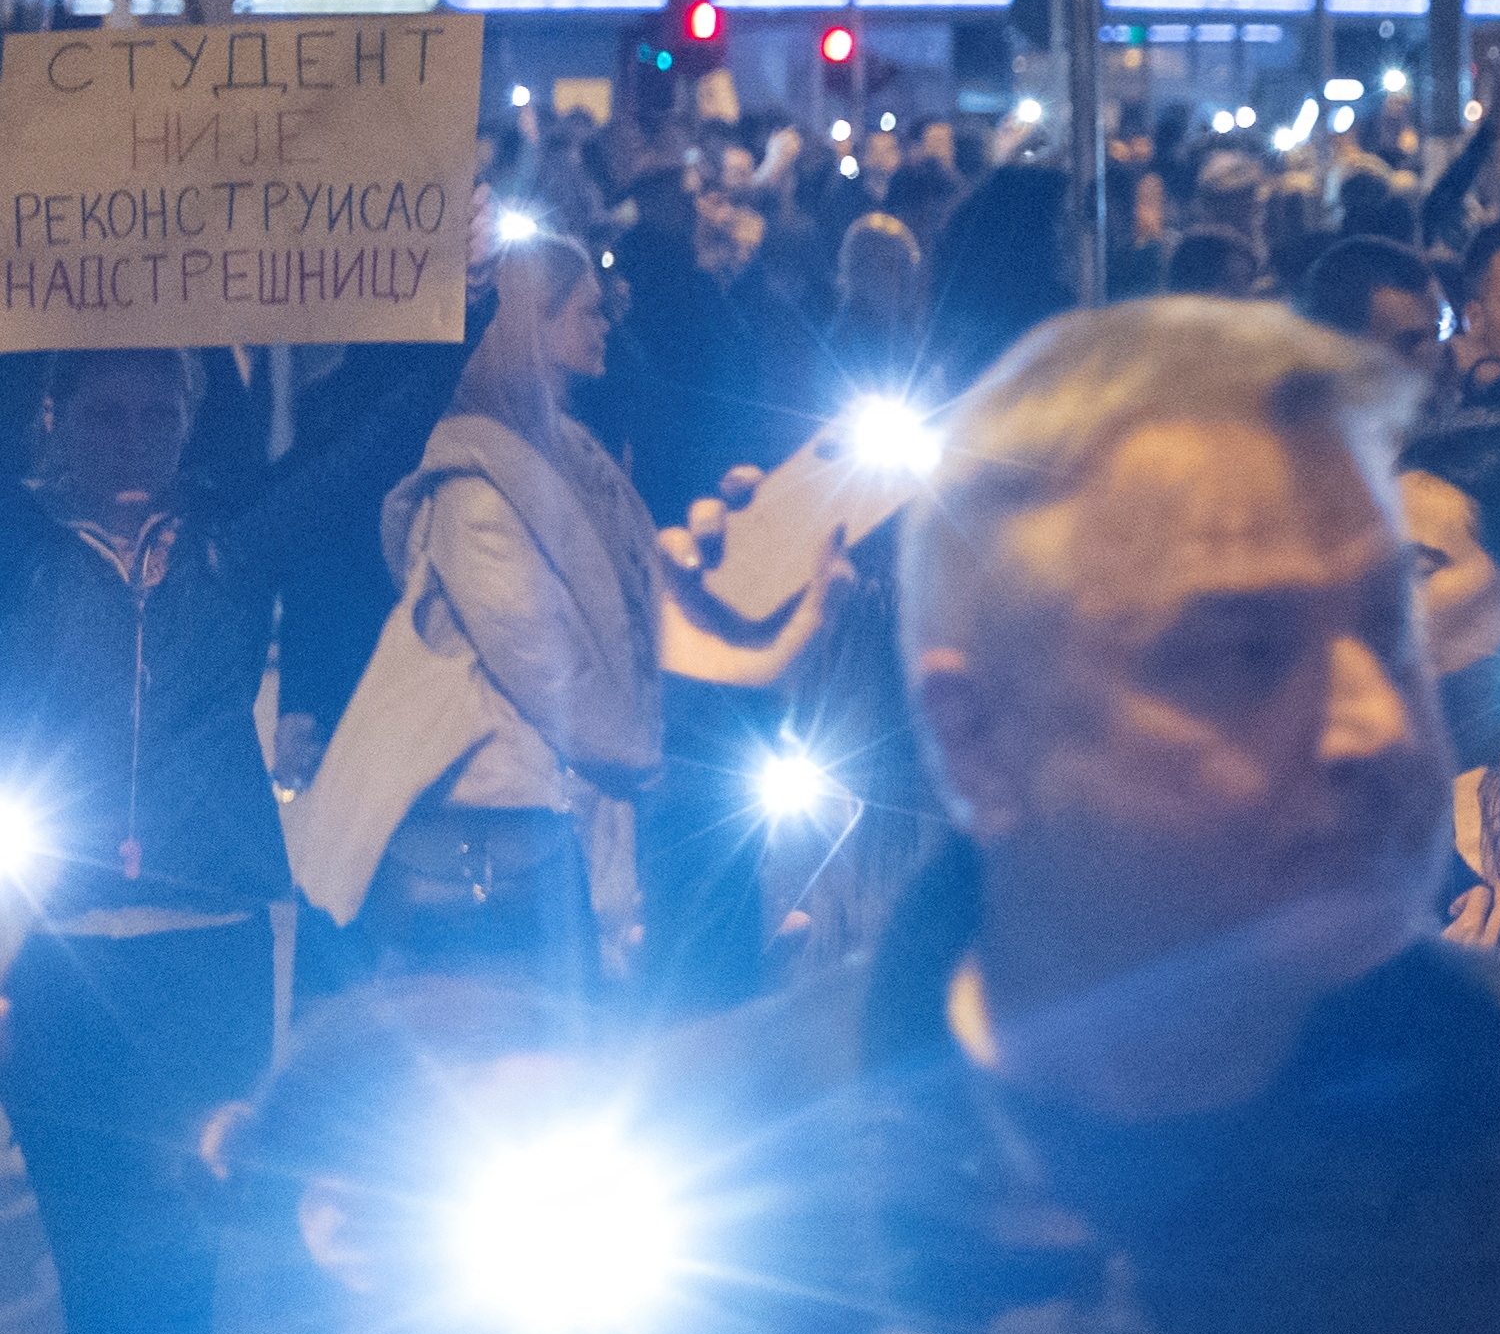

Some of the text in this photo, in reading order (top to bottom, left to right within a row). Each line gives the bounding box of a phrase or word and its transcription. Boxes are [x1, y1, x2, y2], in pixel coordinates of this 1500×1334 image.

[48, 27, 445, 98] СТУДЕНТ
[131, 108, 322, 168] НИЈЕ
[14, 180, 446, 248] РЕКОНСТРУИСАО
[3, 247, 430, 312] НАДСТРЕШНИЦУ
